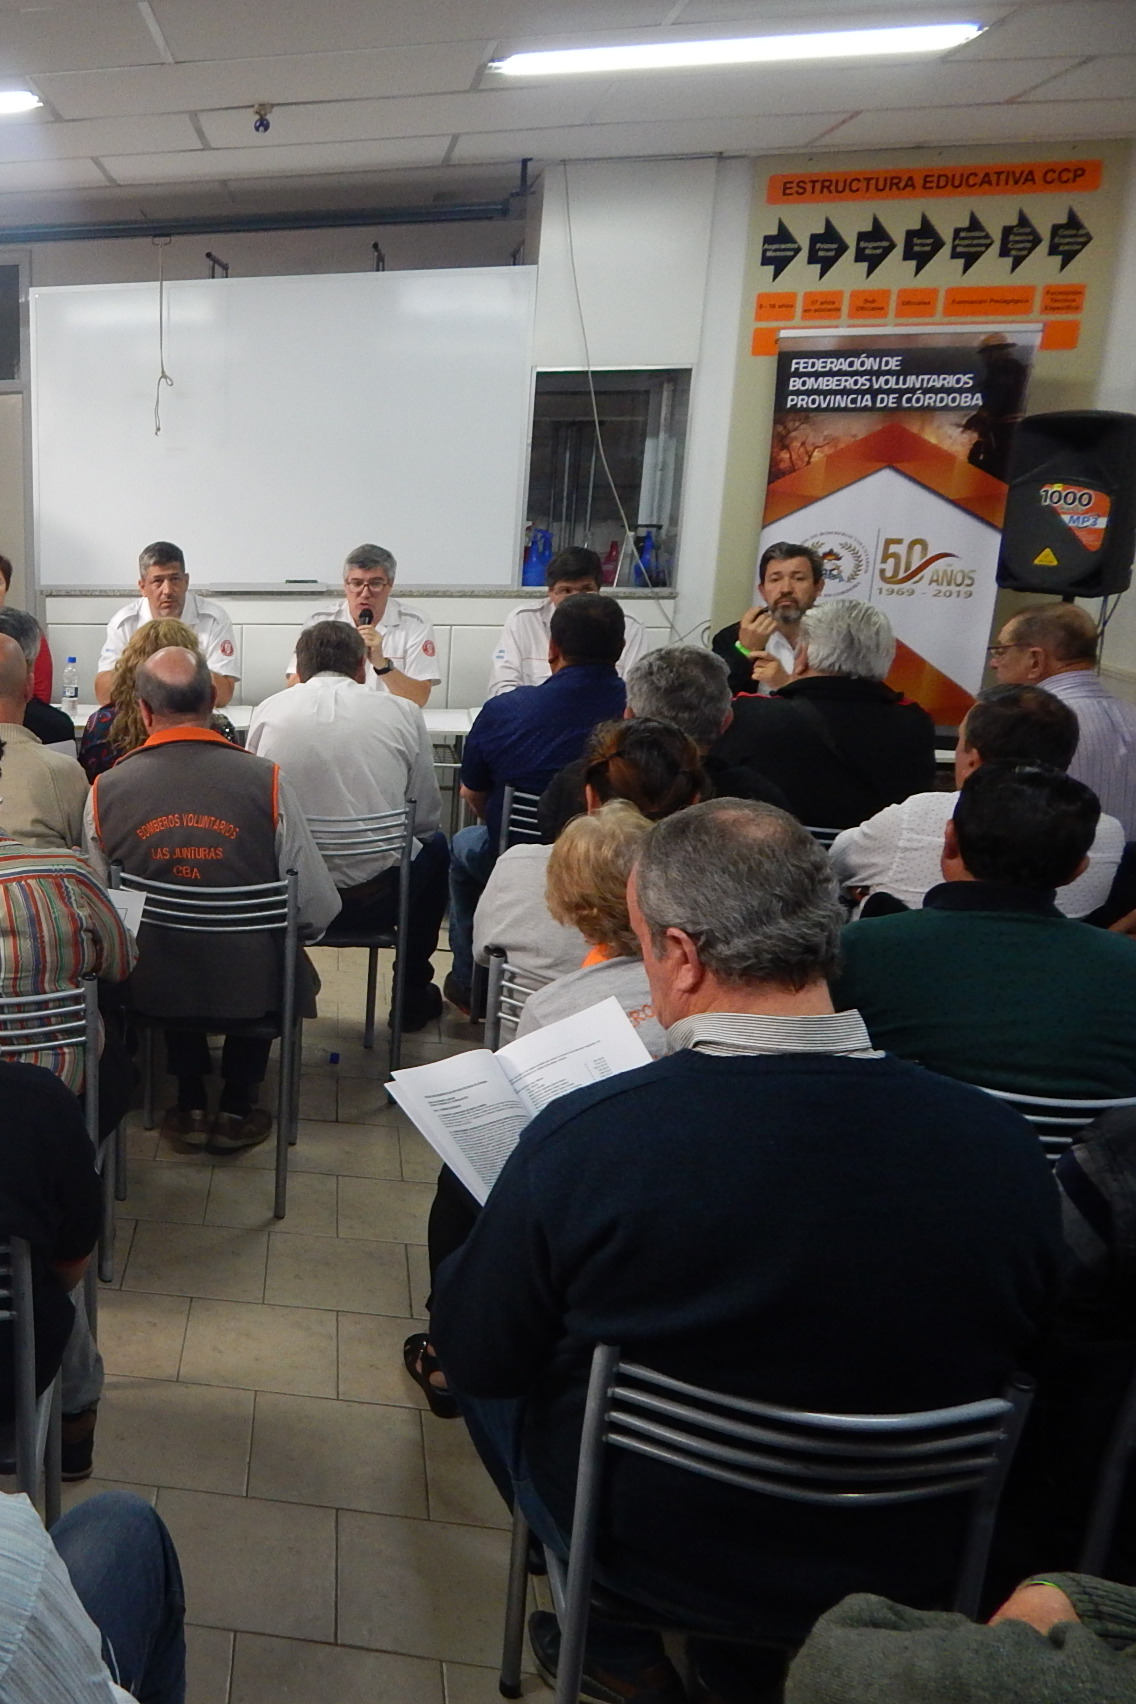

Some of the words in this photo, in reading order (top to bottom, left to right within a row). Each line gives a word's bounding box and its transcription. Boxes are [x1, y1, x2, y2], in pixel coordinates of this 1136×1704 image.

[782, 175, 916, 197] ESTRUCTURA
[922, 170, 1036, 190] EDUCATIVA
[1042, 168, 1086, 184] CCP
[790, 354, 879, 372] FEDERACIÓN
[881, 356, 902, 371] DE
[789, 375, 871, 391] BOMBEROS
[872, 374, 974, 390] VOLUNTARIOS
[786, 394, 872, 409] PROVINCIA
[876, 393, 899, 408] DE
[902, 390, 983, 407] CÓRDOBA
[1040, 489, 1094, 508] 1000
[1068, 515, 1099, 527] MP3
[879, 538, 929, 585] 50
[928, 563, 977, 588] AÑOS
[877, 587, 916, 597] 1969
[932, 589, 973, 599] 2019
[135, 813, 180, 841] BOMBEROS
[182, 813, 240, 840] VOLUNTARIOS
[151, 848, 170, 860] LAS
[172, 847, 223, 860] JUNTURAS
[173, 865, 201, 879] CBA
